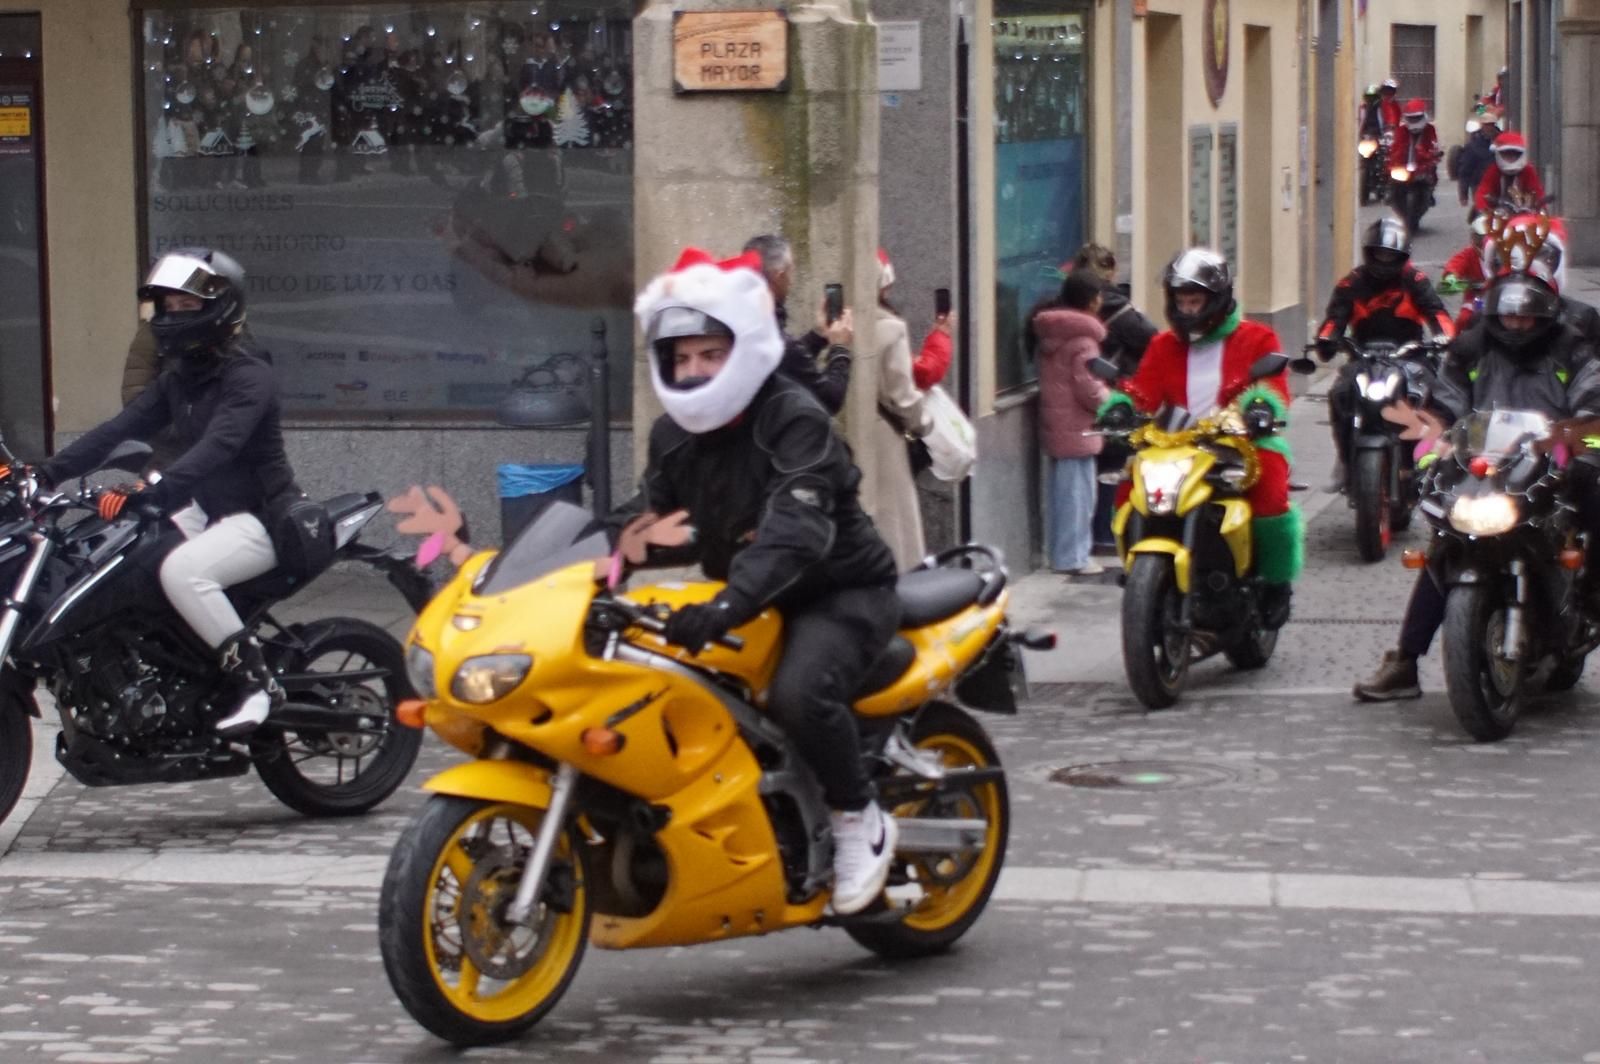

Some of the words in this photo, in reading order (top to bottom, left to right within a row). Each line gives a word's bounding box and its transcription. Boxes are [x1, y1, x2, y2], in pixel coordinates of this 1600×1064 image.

[701, 42, 761, 59] PLAZA
[701, 65, 761, 82] MAYOR
[153, 194, 294, 213] SOLUCIONES
[216, 234, 246, 252] TU
[253, 234, 347, 252] AHORRO
[305, 275, 337, 293] DE
[344, 275, 385, 293] LUZ
[391, 275, 405, 292] Y
